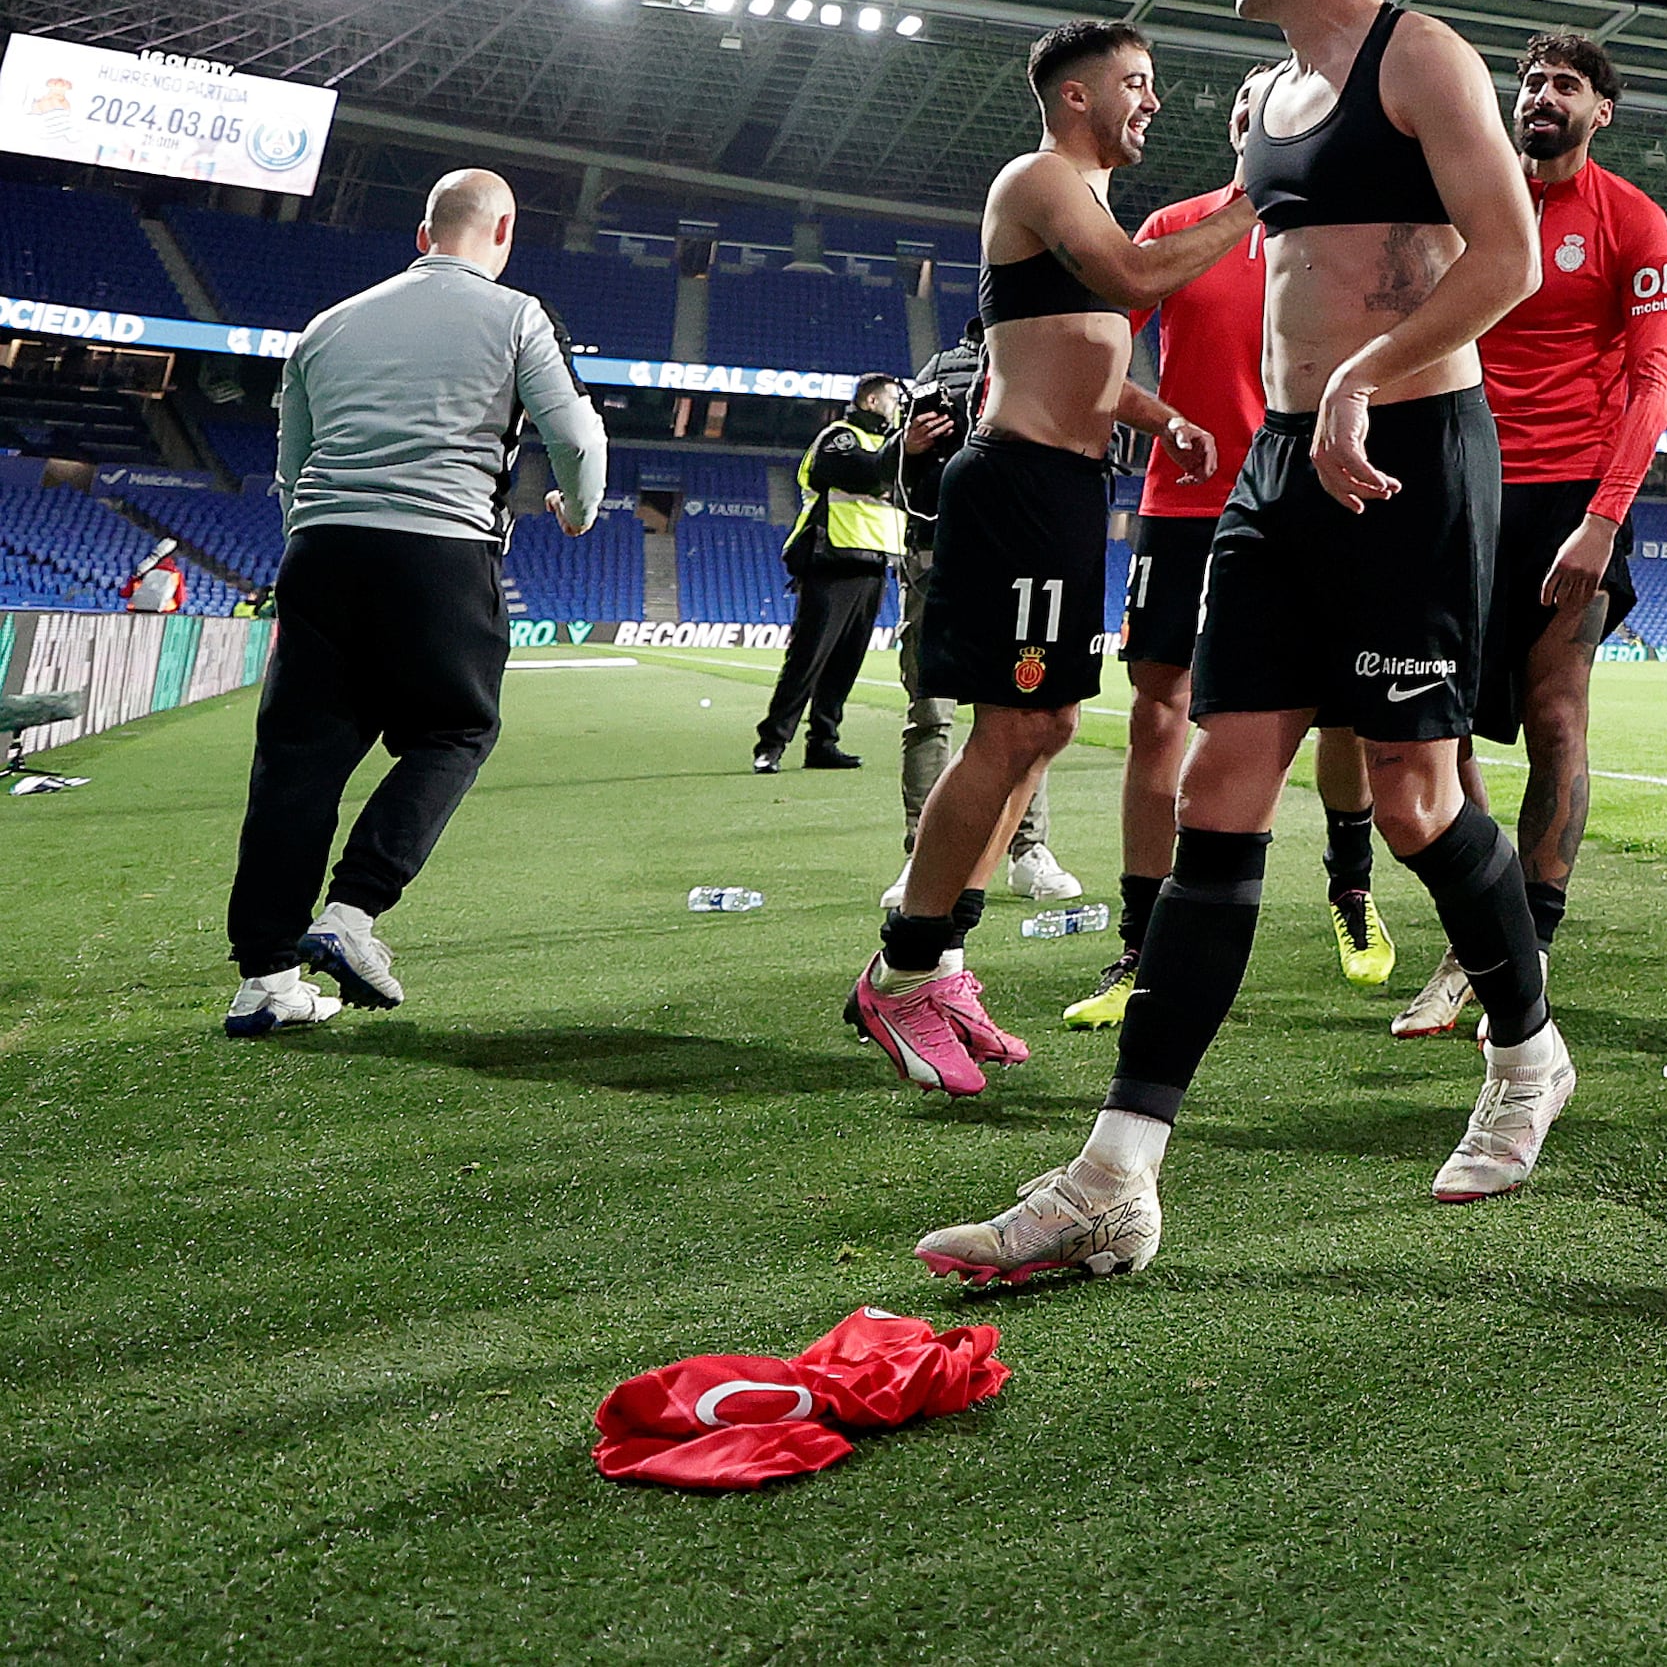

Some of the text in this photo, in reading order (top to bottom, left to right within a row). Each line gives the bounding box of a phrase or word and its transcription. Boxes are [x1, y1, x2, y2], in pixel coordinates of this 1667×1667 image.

[86, 94, 244, 145] 2024.03.05
[657, 362, 749, 394] REAL
[1012, 577, 1063, 642] 11
[613, 620, 743, 647] BECOME
